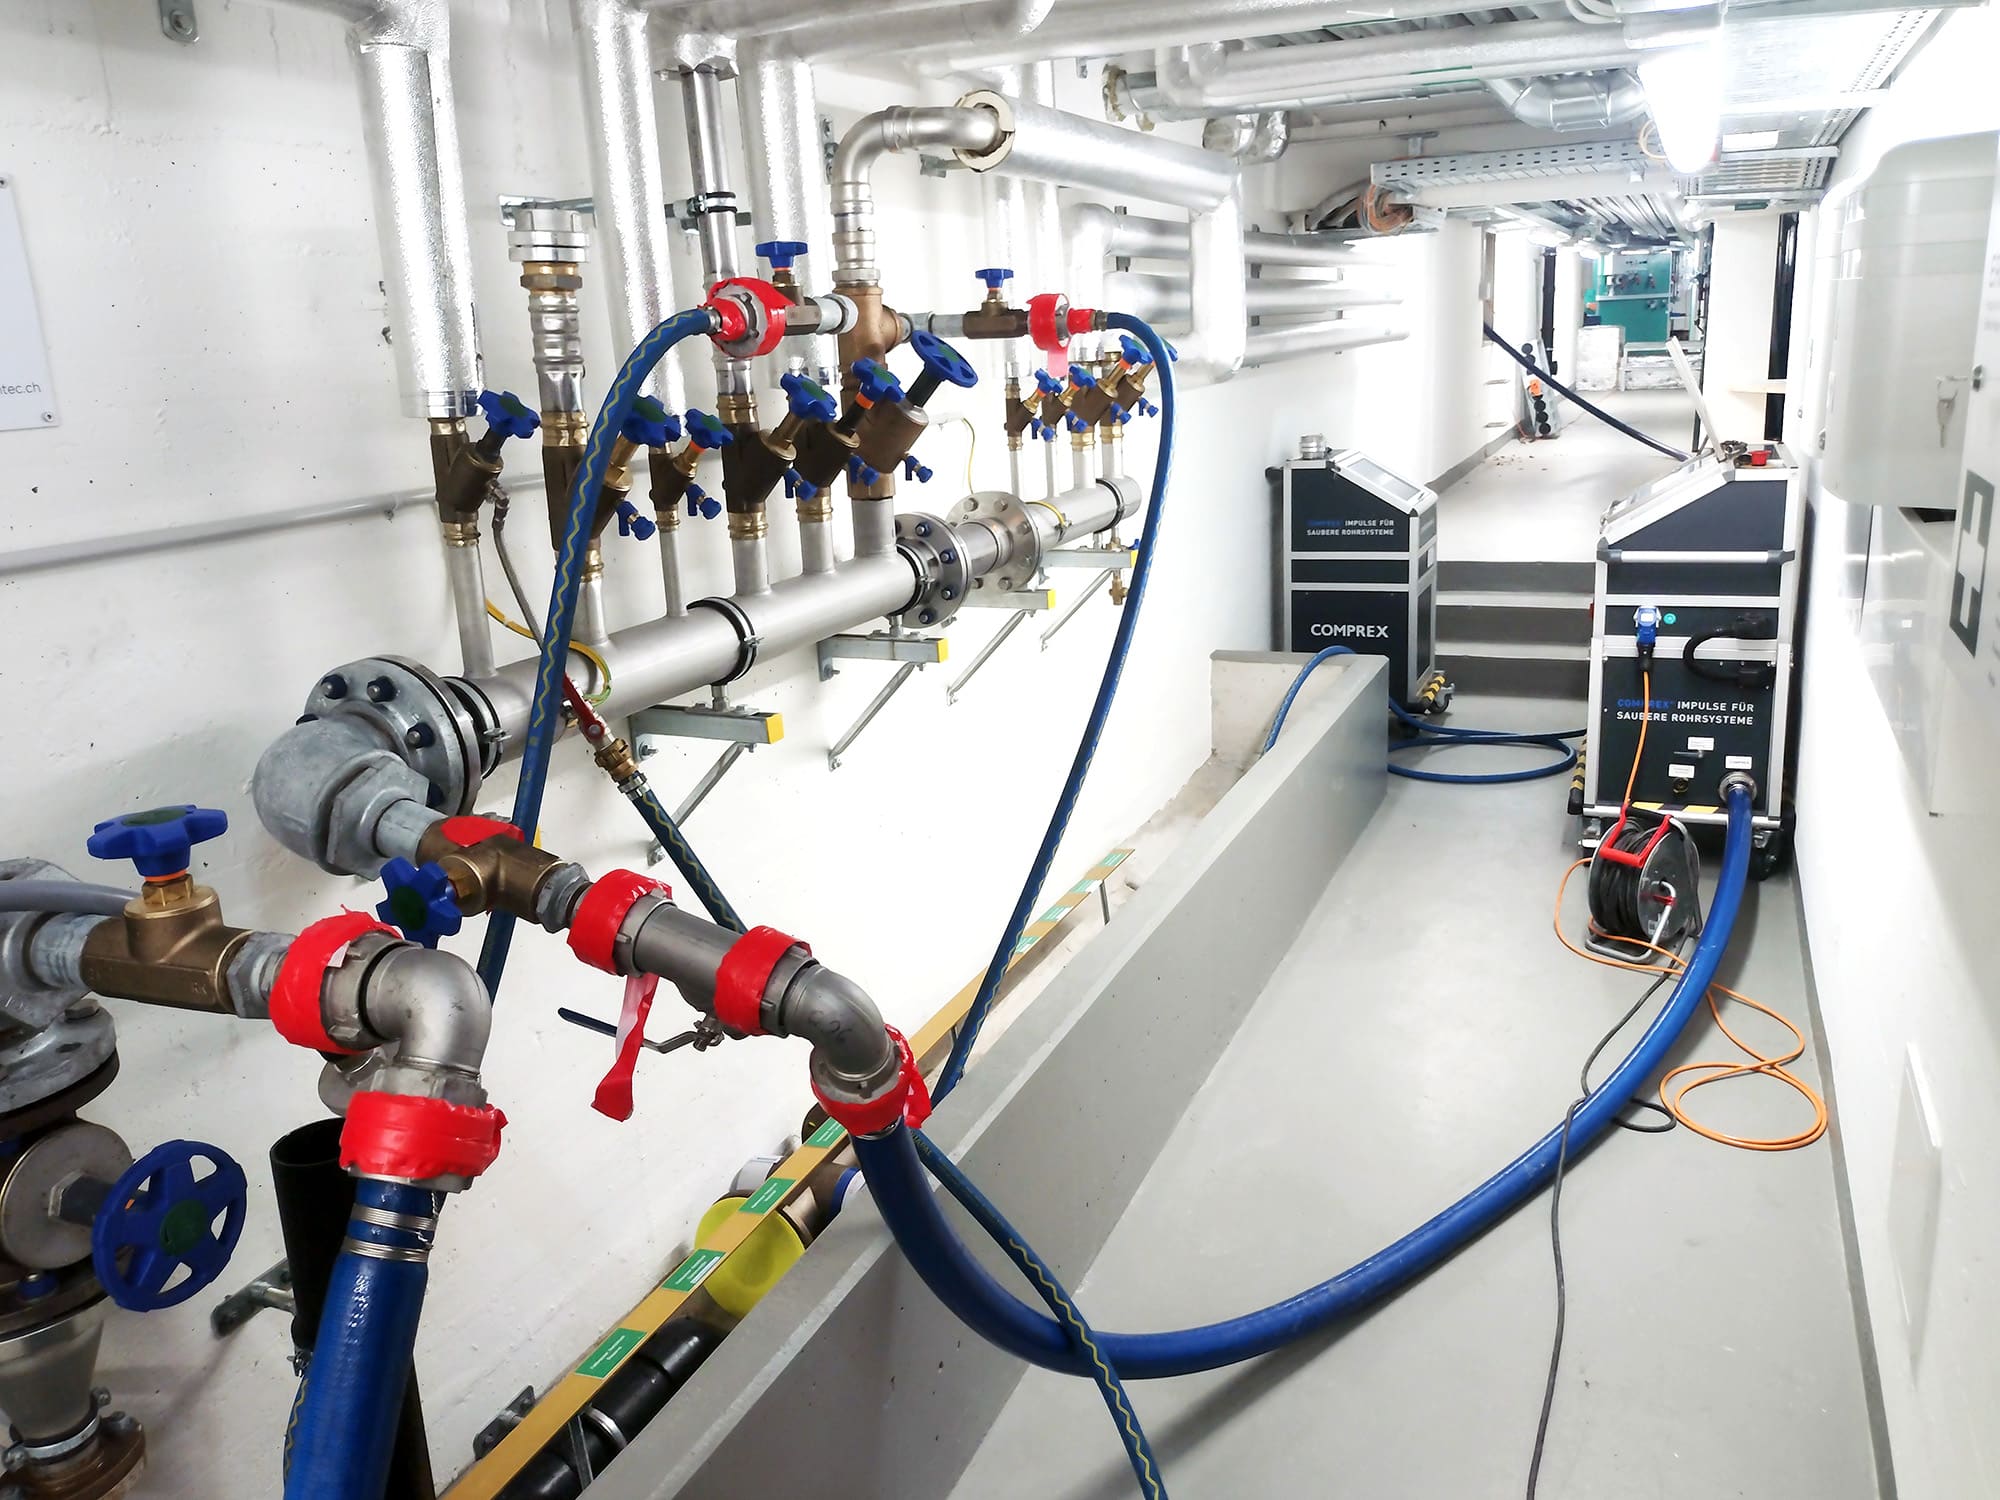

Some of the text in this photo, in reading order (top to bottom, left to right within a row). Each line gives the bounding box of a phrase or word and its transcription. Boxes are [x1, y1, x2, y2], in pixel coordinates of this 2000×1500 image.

[1379, 518, 1394, 527] FÜR
[1310, 623, 1389, 638] COMPREX
[1677, 700, 1727, 711] IMPULSE
[1731, 701, 1754, 712] FÜR
[1616, 711, 1754, 725] SAUBERE ROHRSYSTEME
